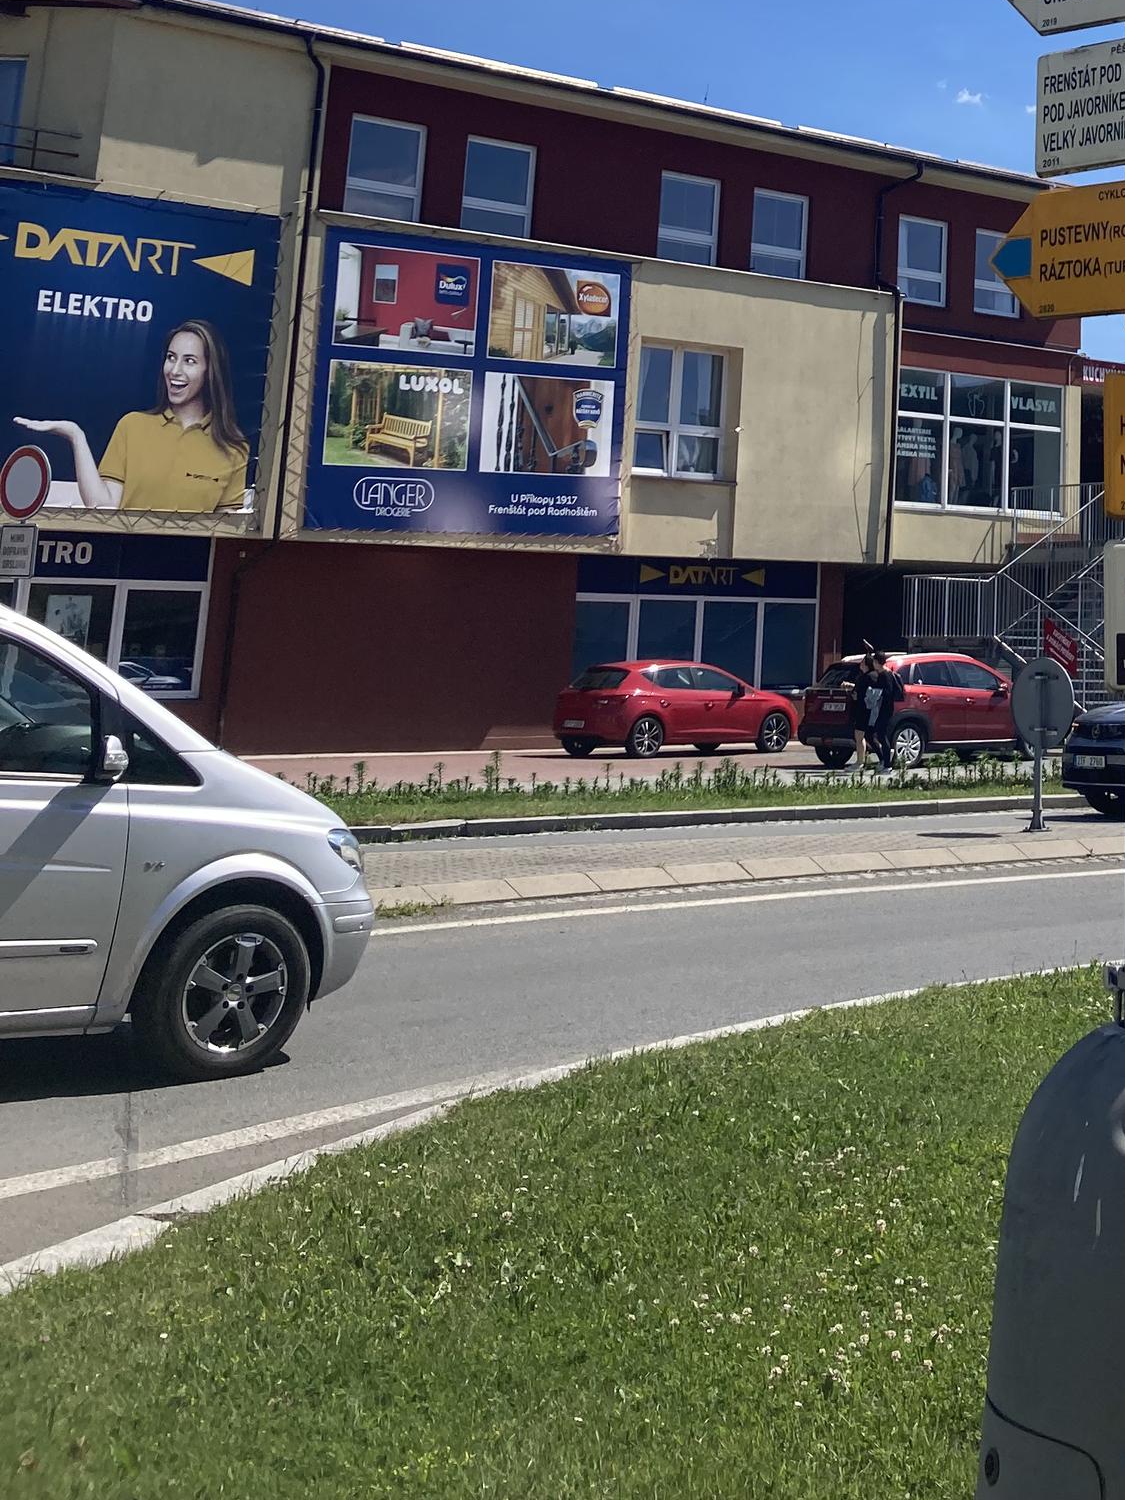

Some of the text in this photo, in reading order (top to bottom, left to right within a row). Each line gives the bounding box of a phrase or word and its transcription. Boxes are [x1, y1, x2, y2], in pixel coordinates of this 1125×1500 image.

[1043, 64, 1098, 96] FRENŠTÁT
[1100, 65, 1122, 86] POD
[1043, 104, 1064, 124] POD
[1043, 125, 1077, 152] VELKÝ
[1040, 221, 1109, 248] PUSTEVNY
[14, 221, 196, 276] DATART
[1039, 256, 1101, 282] RÁZTOKA
[439, 280, 465, 290] Dulux
[37, 289, 153, 322] ELEKTRO
[399, 374, 464, 395] LUXOL
[1011, 396, 1056, 413] VLASTA
[362, 481, 426, 507] LANGER
[511, 493, 578, 506] U Příkopy 1917
[375, 507, 411, 517] DROGERIE
[488, 504, 598, 517] Frenštát pod Radhoštěm
[669, 565, 739, 585] DATART
